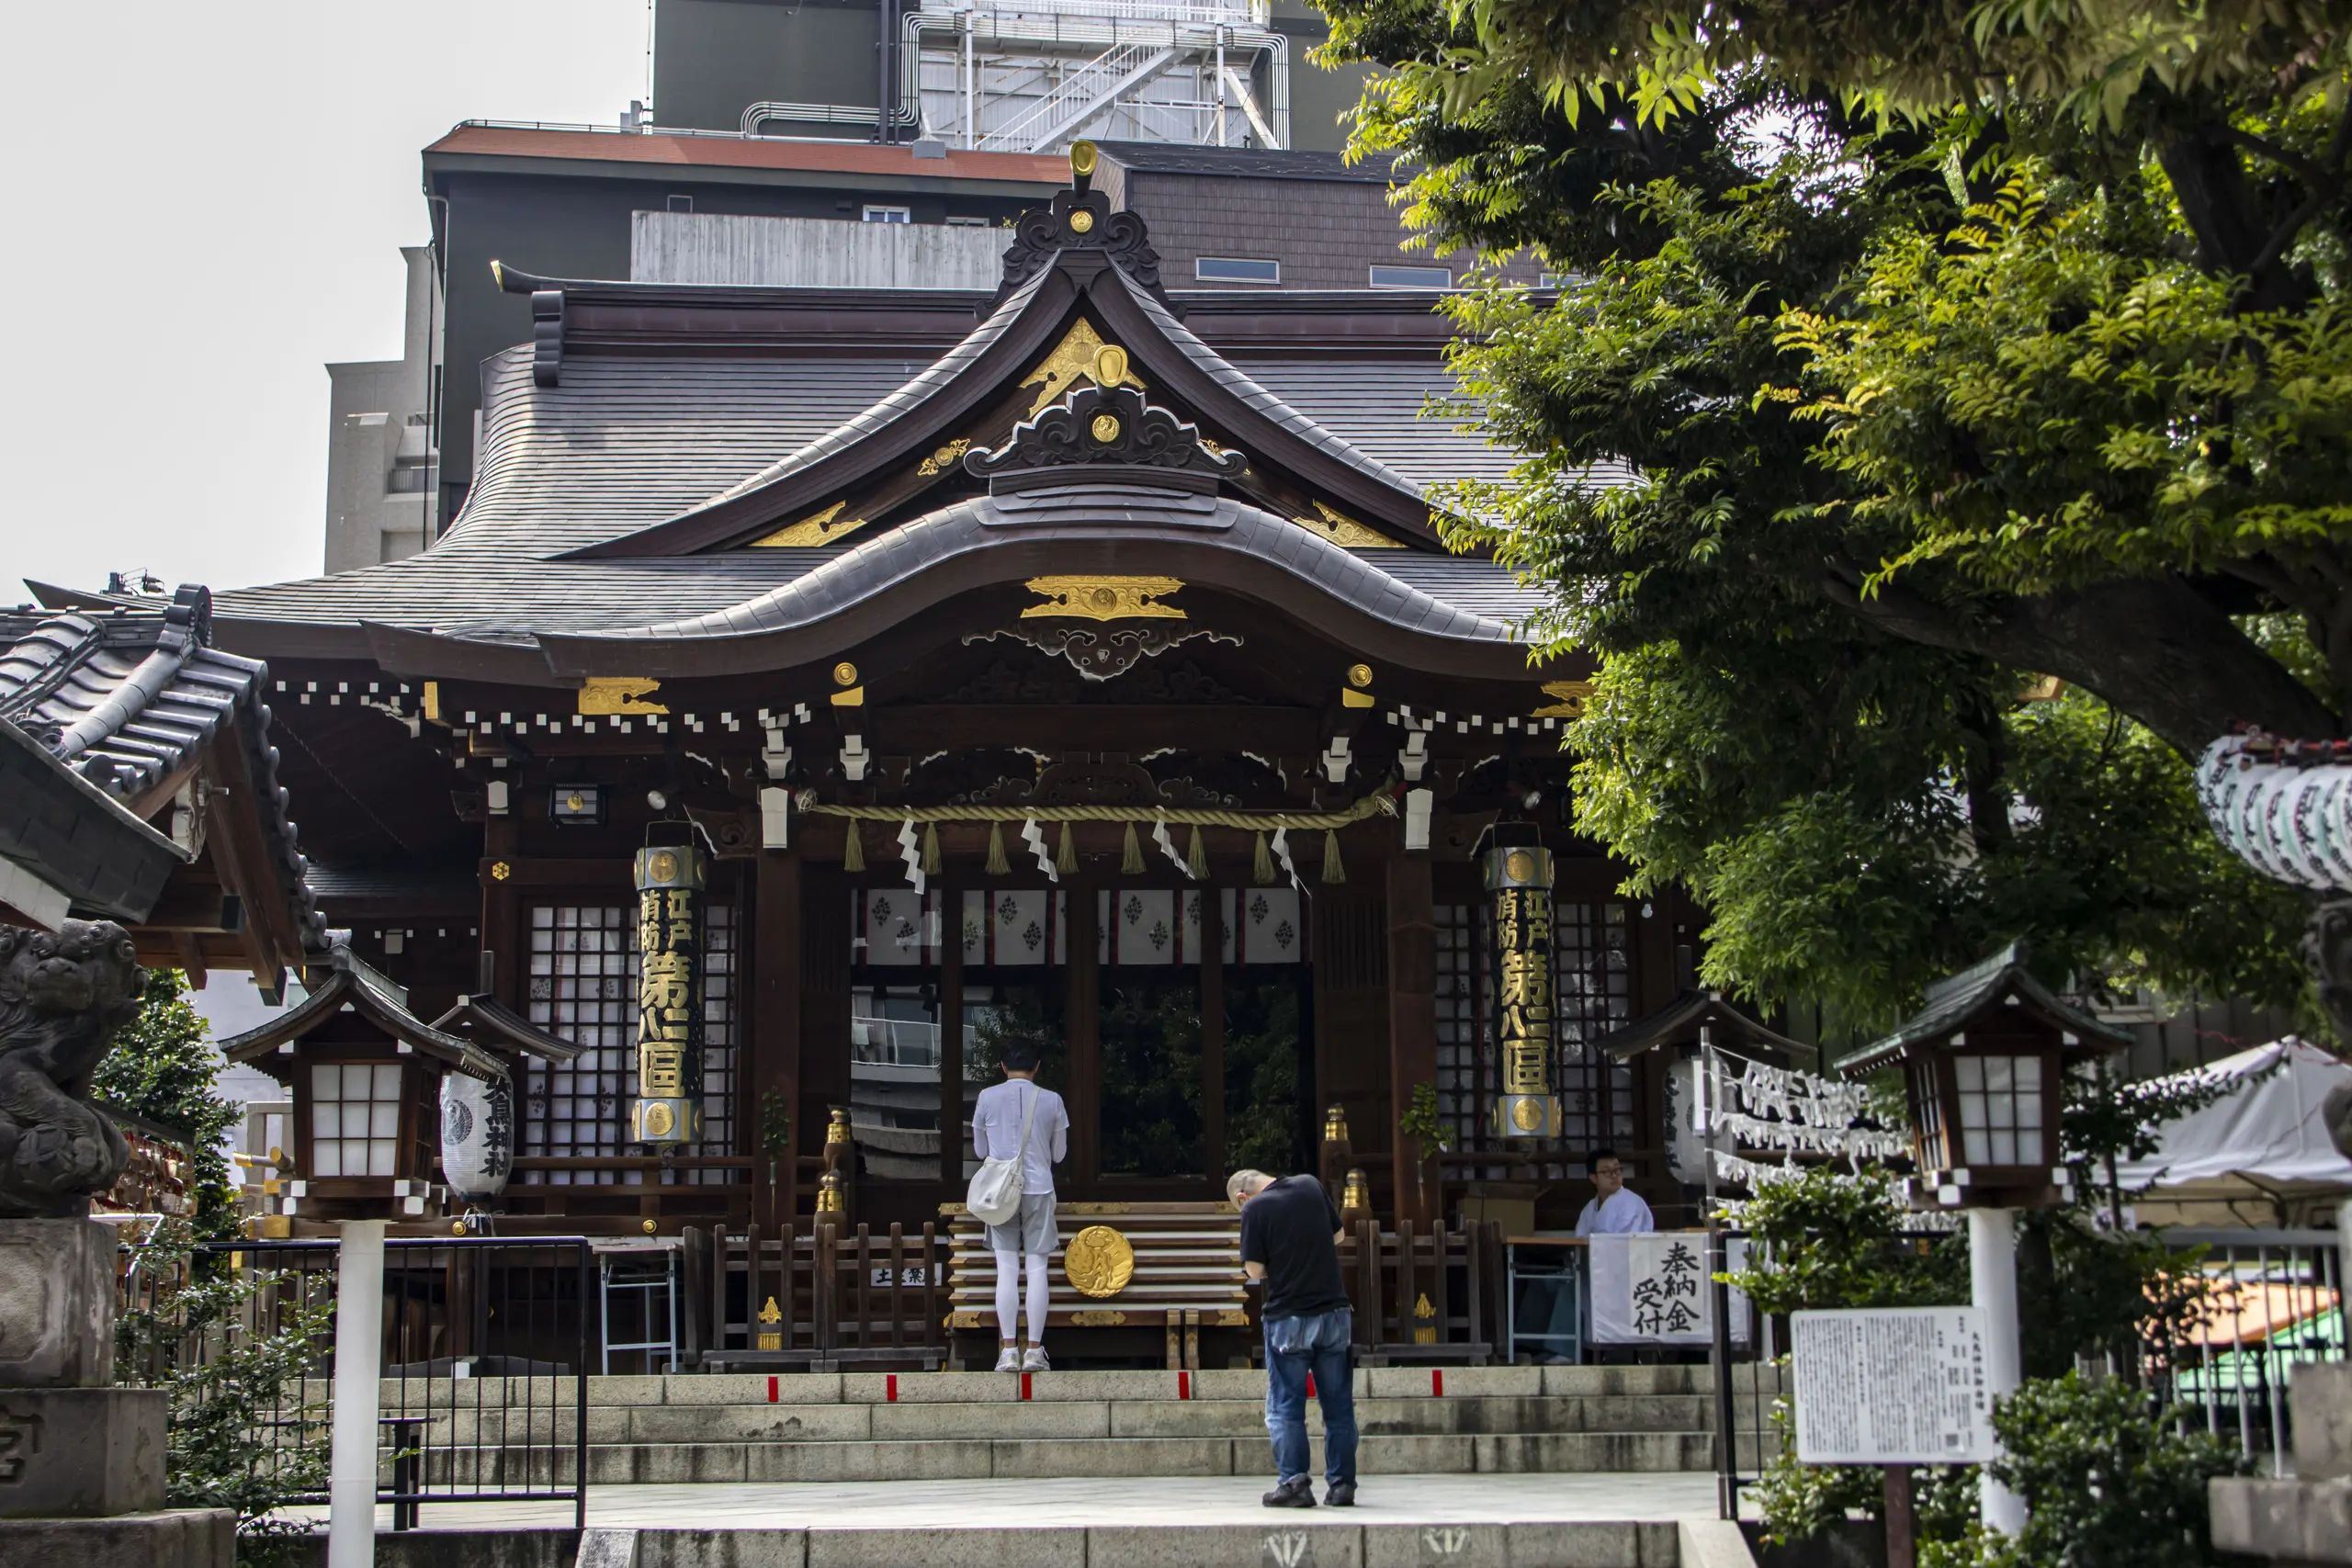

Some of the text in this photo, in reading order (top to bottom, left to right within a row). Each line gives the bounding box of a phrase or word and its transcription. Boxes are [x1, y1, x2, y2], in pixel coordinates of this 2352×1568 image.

[639, 889, 661, 951] 消防
[1497, 888, 1518, 950] 消防
[876, 1268, 937, 1283] 土禁
[1633, 1278, 1664, 1335] 受付
[1661, 1242, 1701, 1332] 奉納金
